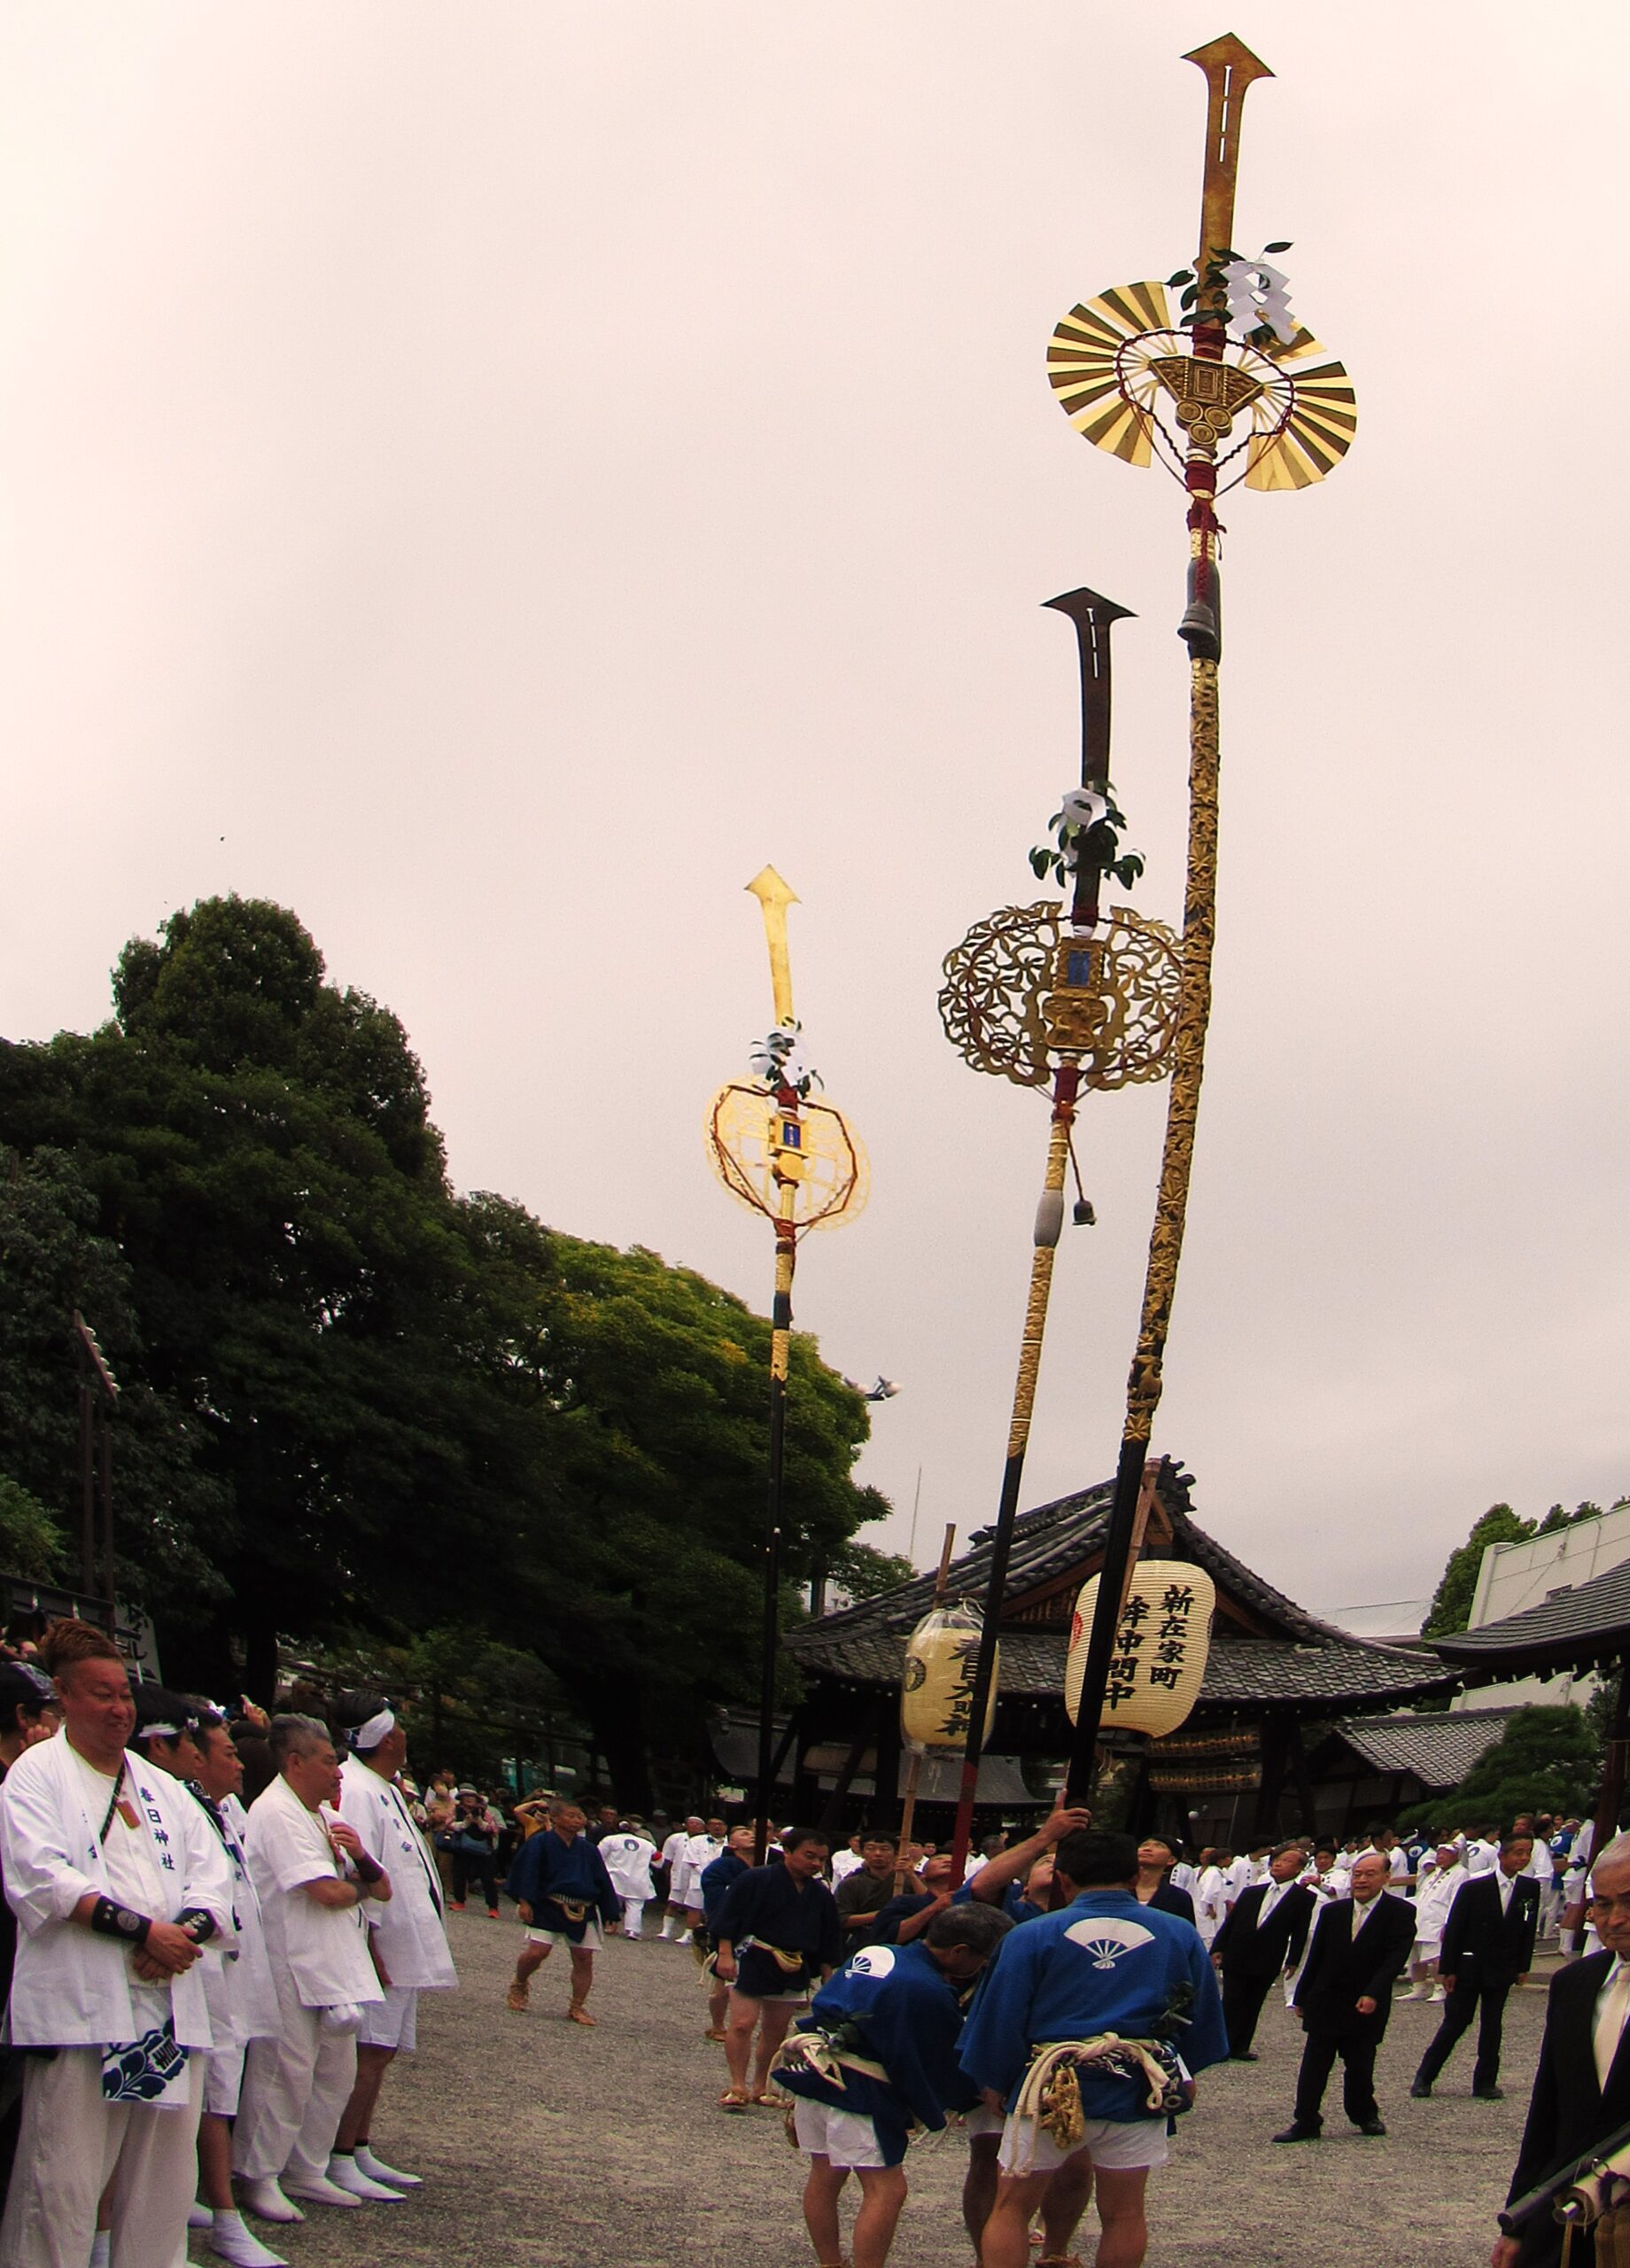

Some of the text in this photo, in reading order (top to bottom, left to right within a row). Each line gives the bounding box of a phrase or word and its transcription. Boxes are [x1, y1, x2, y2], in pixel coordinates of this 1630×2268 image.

[1150, 1584, 1195, 1690] 新在家町
[139, 1786, 175, 1870] 春日神社
